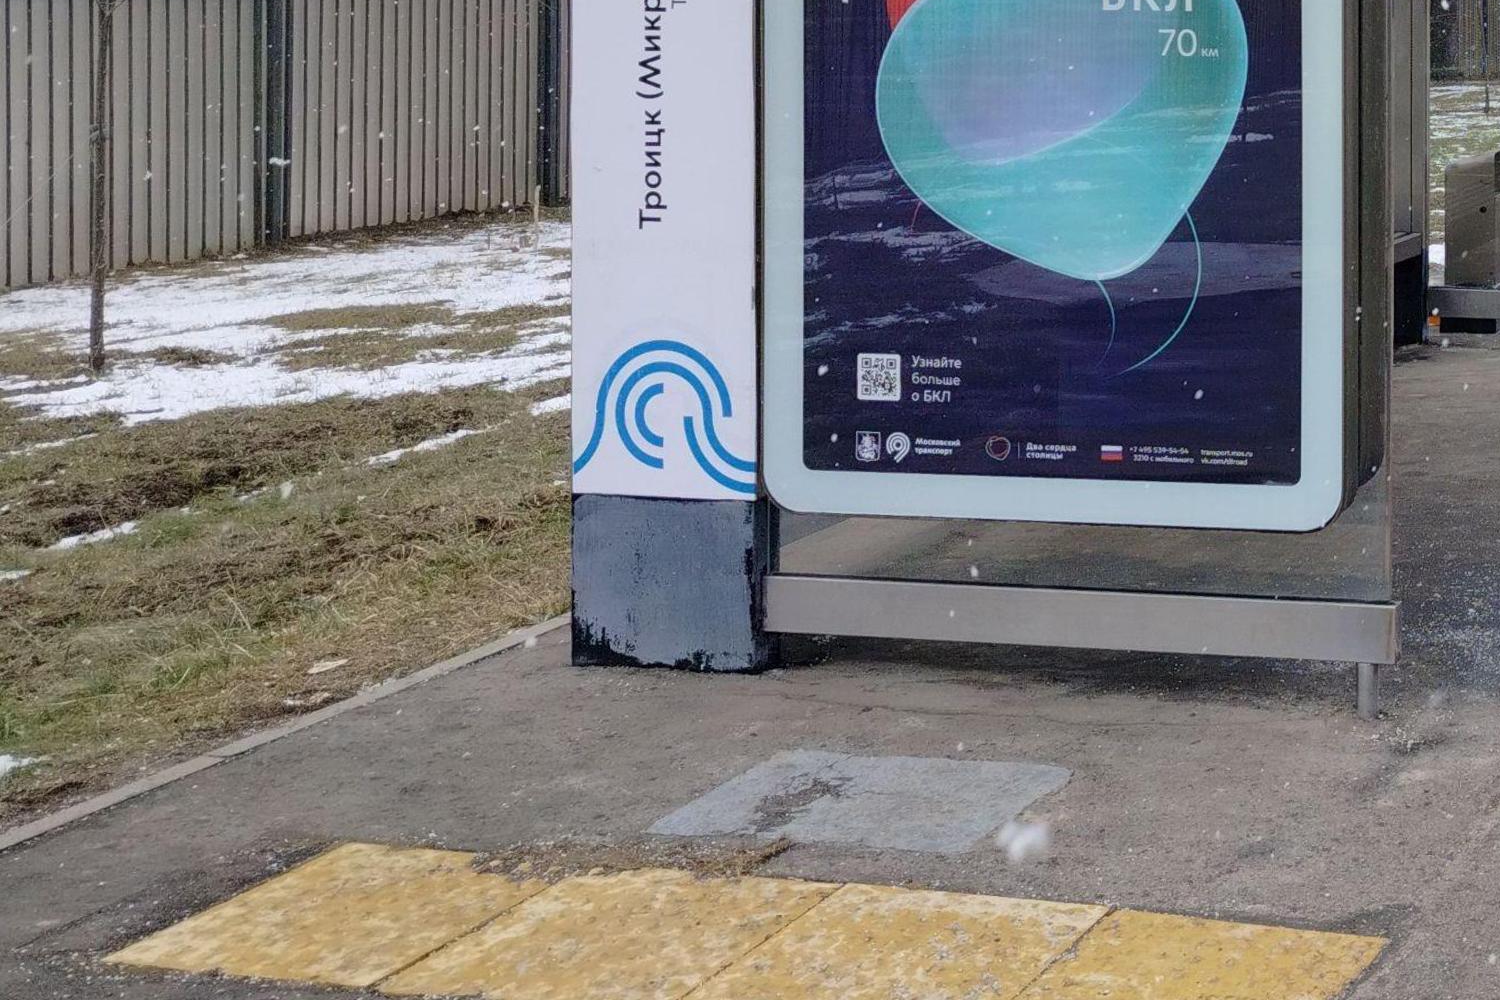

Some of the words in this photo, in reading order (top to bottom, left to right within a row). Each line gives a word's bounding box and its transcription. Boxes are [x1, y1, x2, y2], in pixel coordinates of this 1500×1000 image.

[1158, 29, 1197, 57] 70
[638, 110, 667, 229] Троицк
[911, 354, 962, 369] Узнайте
[911, 372, 961, 386] больше
[911, 391, 920, 402] о
[923, 389, 952, 403] БКЛ
[915, 437, 961, 447] Московский
[914, 447, 953, 456] транспорт
[1026, 452, 1064, 460] столицы
